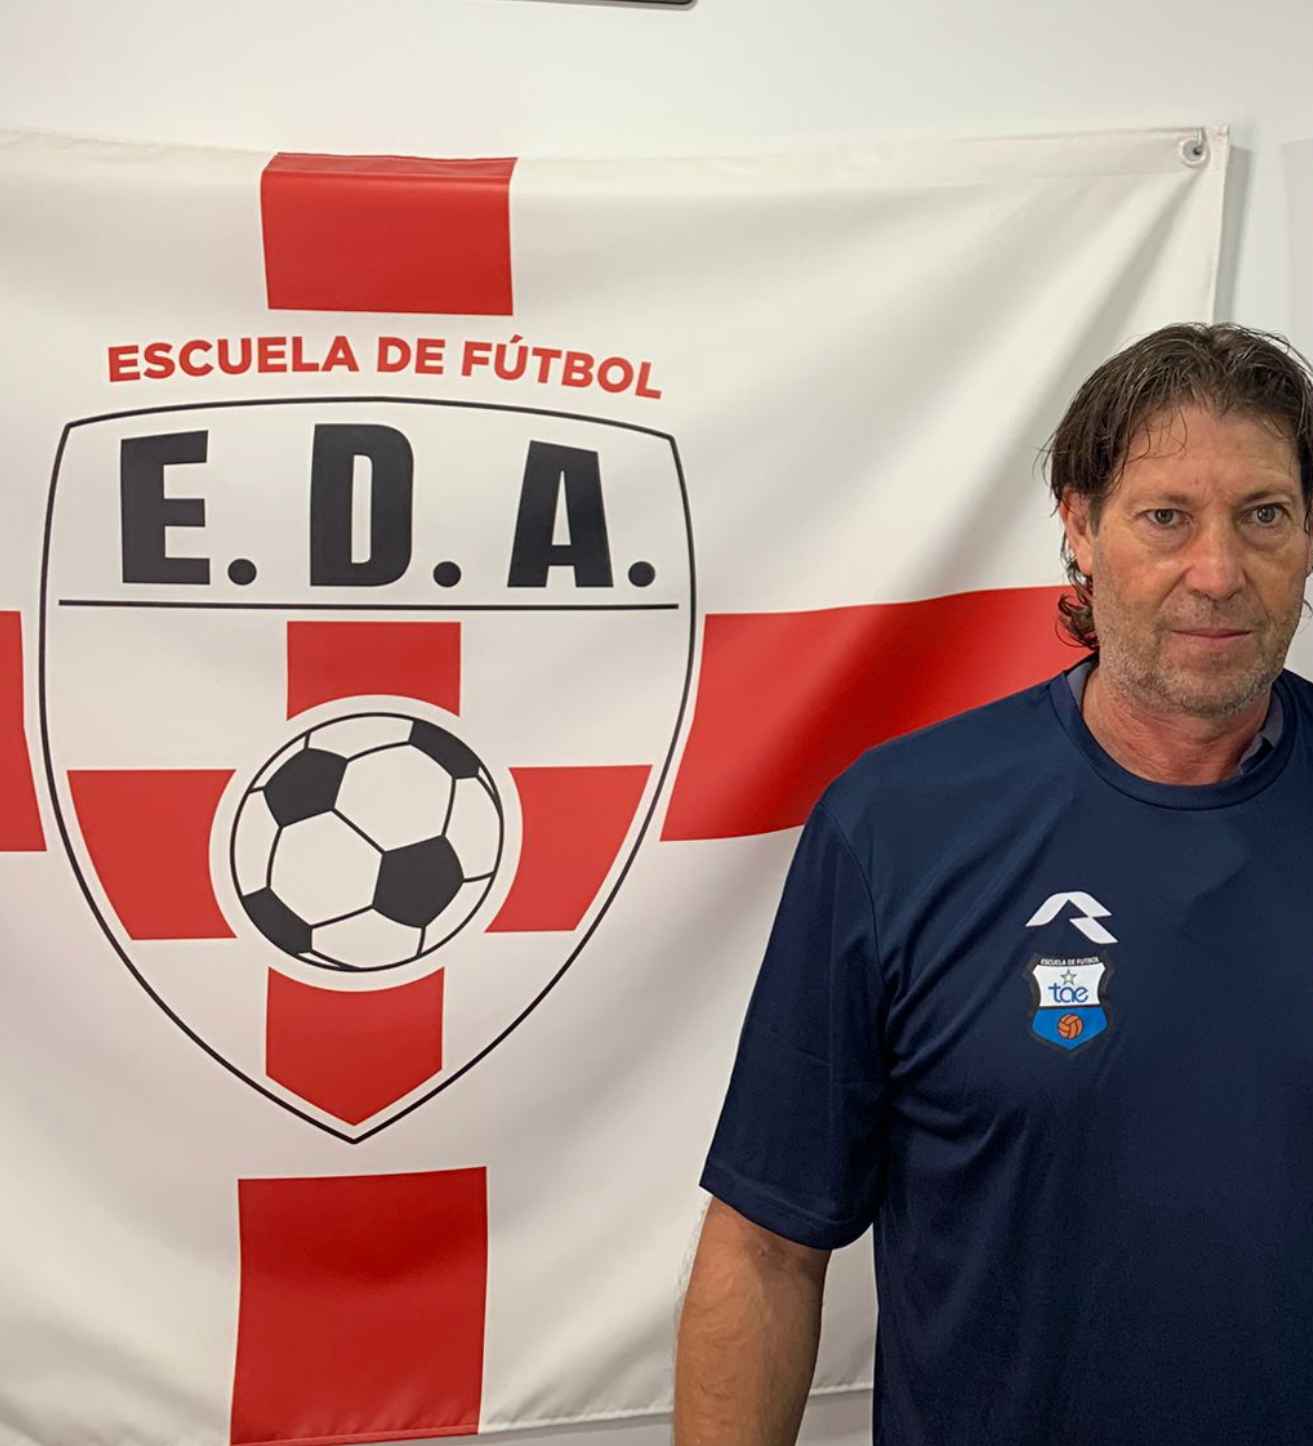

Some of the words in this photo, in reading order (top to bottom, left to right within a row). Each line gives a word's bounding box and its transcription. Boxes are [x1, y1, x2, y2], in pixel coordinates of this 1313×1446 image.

[108, 336, 359, 382] ESCUELA
[377, 336, 445, 375] DE
[461, 334, 662, 400] FÚTBOL
[1048, 982, 1089, 1003] tae
